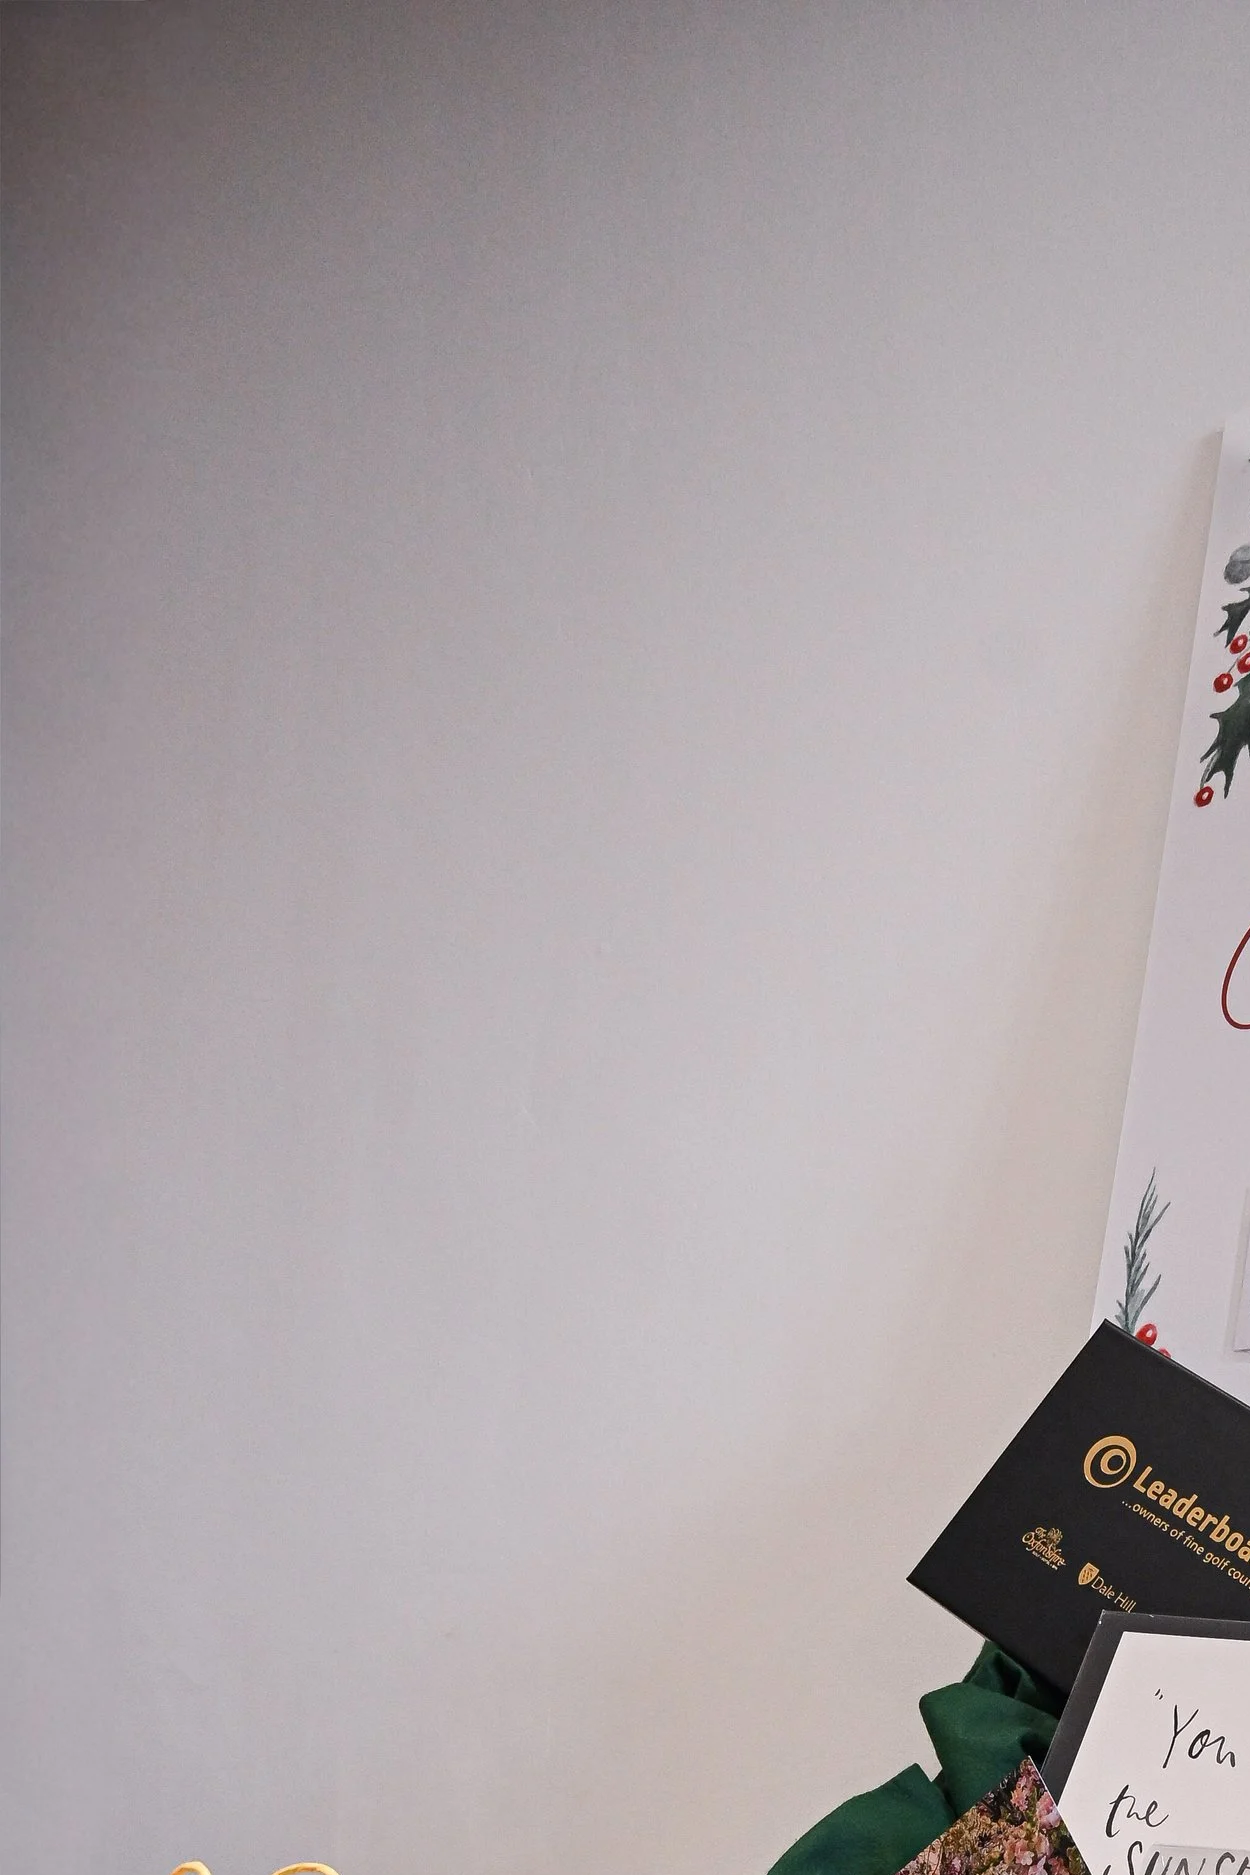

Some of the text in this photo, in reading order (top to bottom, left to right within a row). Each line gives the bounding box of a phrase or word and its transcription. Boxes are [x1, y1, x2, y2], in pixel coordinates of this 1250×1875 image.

[1170, 1529, 1185, 1540] of
[1183, 1535, 1204, 1555] fine
[1203, 1552, 1230, 1570] golf
[1091, 1576, 1136, 1613] Dale Hill
[1105, 1784, 1169, 1838] the
